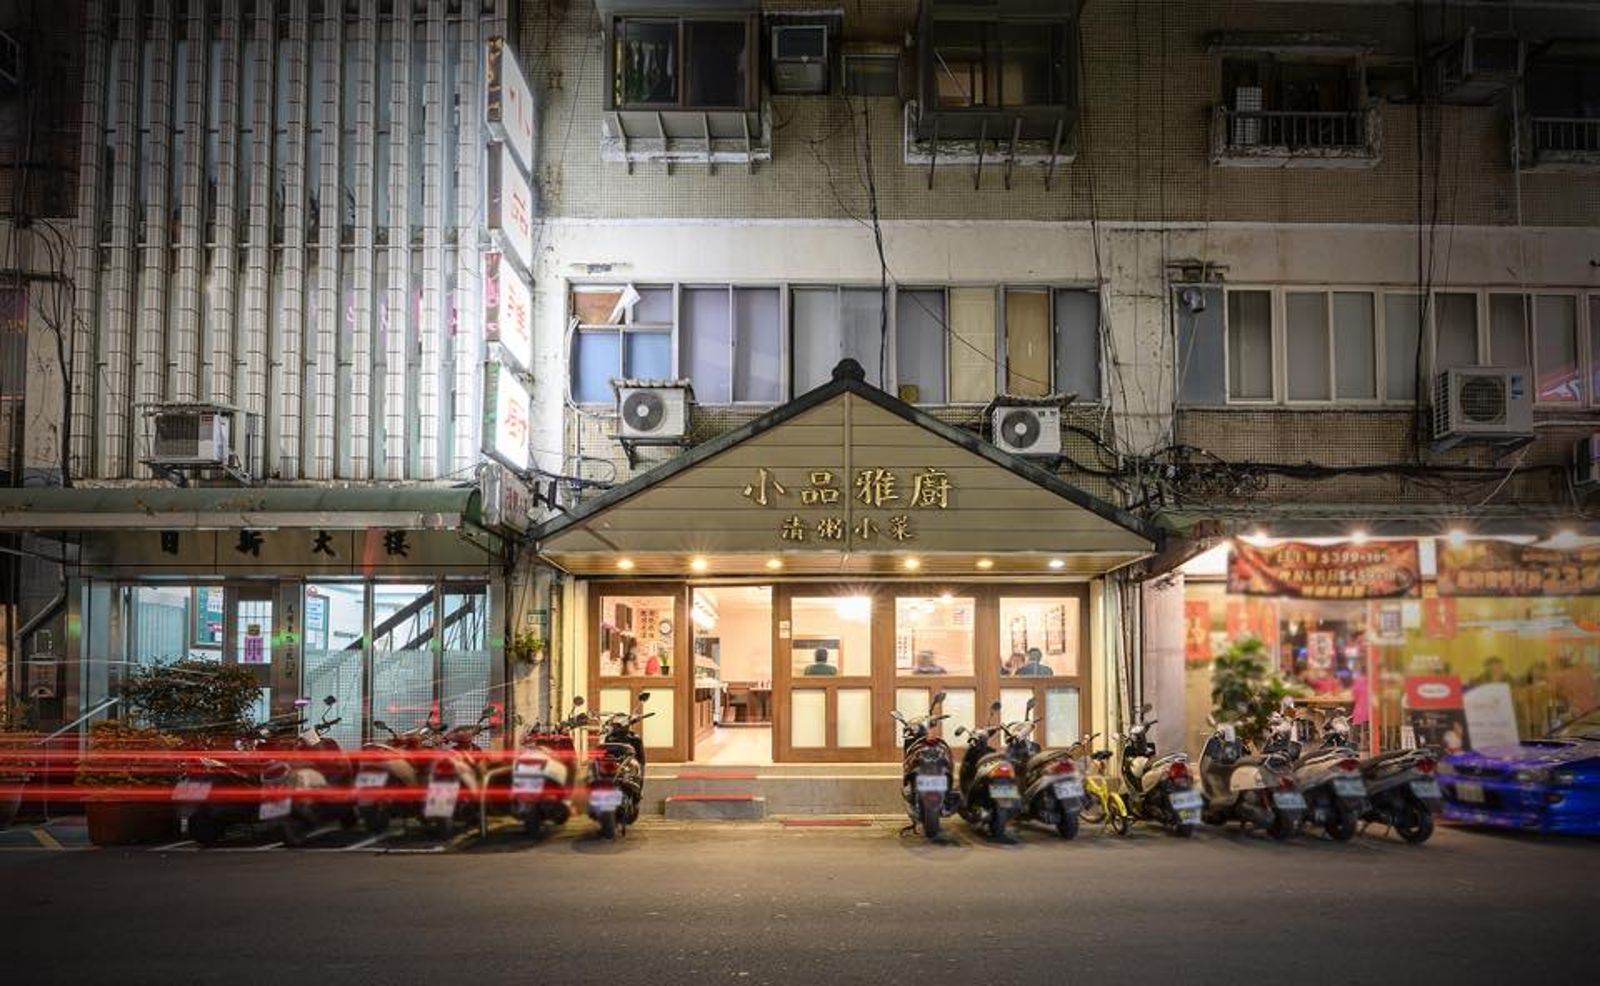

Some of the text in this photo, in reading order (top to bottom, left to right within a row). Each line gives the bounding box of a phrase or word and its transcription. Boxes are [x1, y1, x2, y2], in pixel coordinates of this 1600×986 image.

[744, 467, 952, 508] 小品雅廚
[781, 515, 913, 541] 清粥小菜
